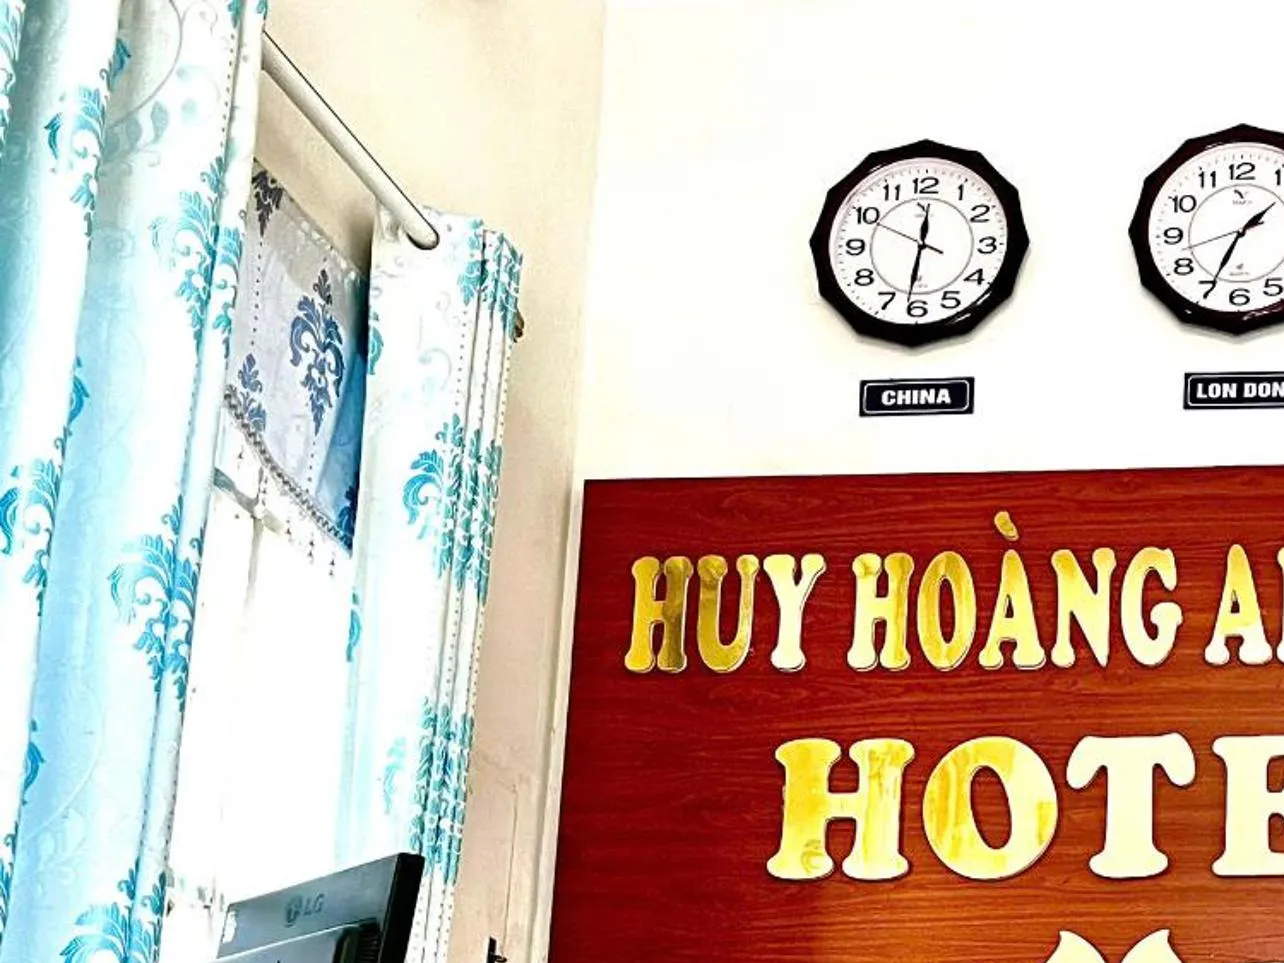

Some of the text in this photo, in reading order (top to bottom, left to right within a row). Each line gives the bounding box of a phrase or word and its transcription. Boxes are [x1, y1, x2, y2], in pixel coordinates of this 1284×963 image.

[1198, 170, 1217, 189] 11
[1228, 161, 1256, 181] 12
[1274, 168, 1281, 186] 1
[882, 183, 901, 201] 11
[912, 176, 940, 195] 12
[957, 183, 964, 201] 1
[1171, 194, 1197, 213] 10
[854, 206, 880, 225] 10
[969, 204, 991, 223] 2
[977, 235, 998, 255] 3
[1163, 227, 1184, 246] 9
[845, 238, 866, 256] 9
[1173, 257, 1195, 276] 8
[853, 268, 875, 287] 8
[963, 268, 985, 286] 4
[1198, 280, 1217, 300] 7
[1262, 277, 1284, 297] 5
[877, 291, 897, 311] 7
[940, 290, 962, 310] 5
[1228, 288, 1251, 306] 6
[906, 300, 929, 318] 6
[880, 388, 951, 406] CHINA
[1196, 382, 1237, 399] LON
[624, 552, 826, 673] HUY
[847, 510, 1184, 673] HOÀNG
